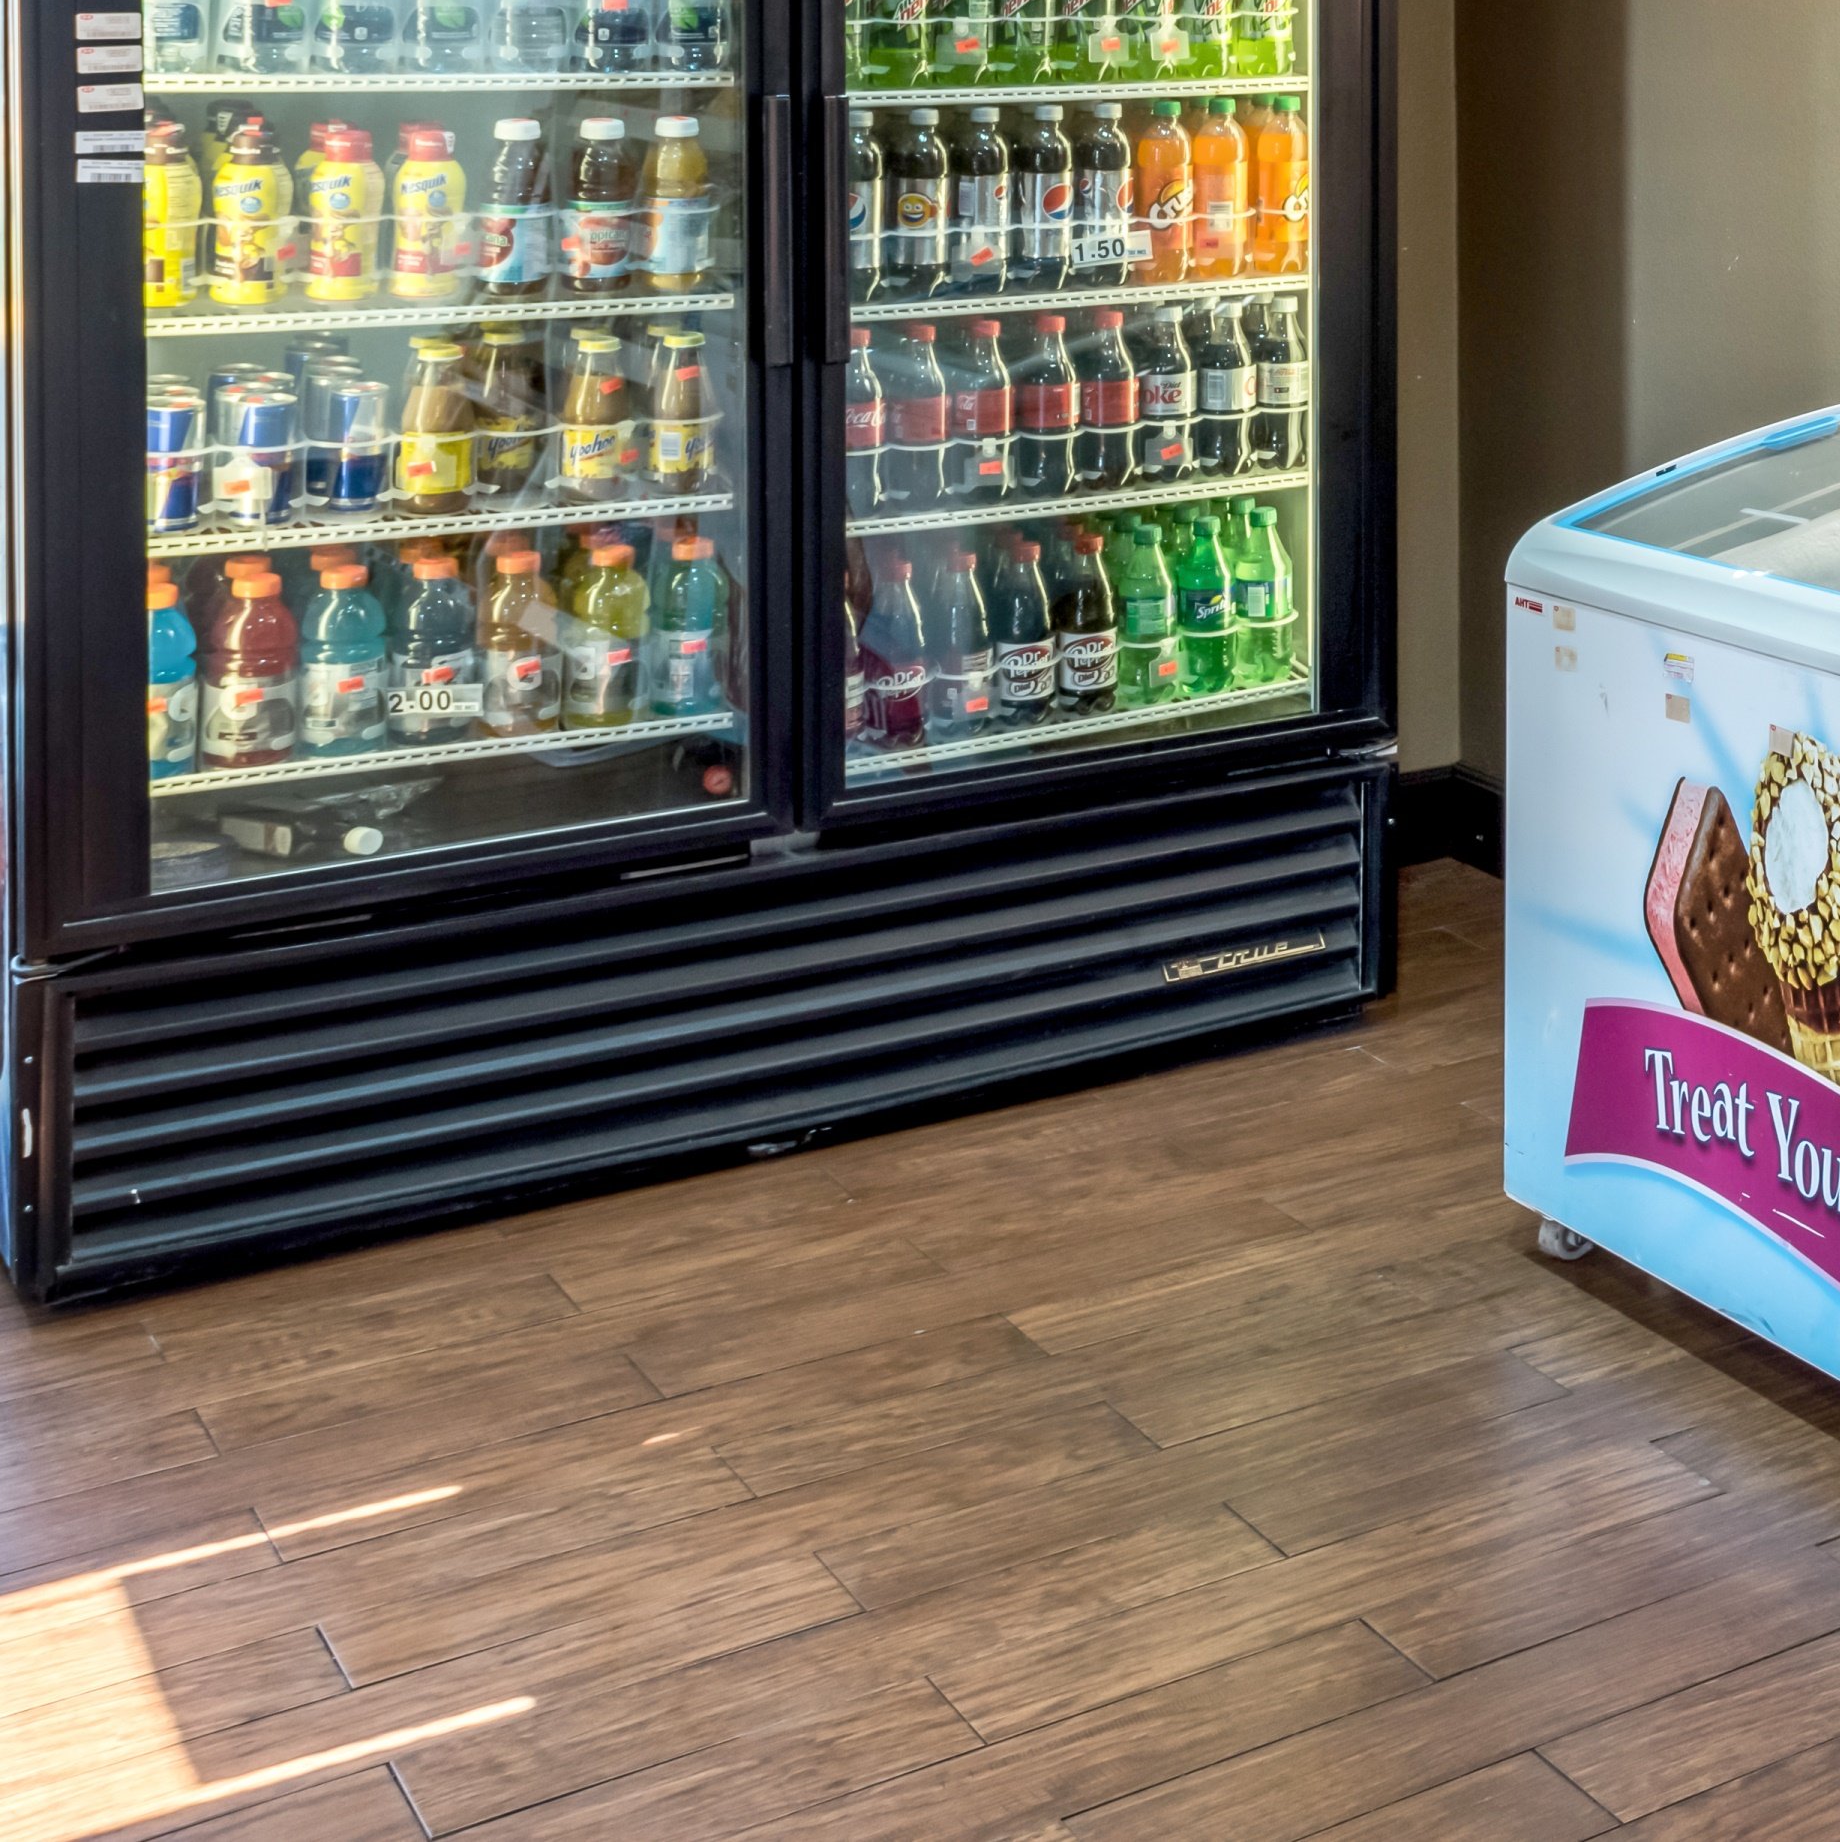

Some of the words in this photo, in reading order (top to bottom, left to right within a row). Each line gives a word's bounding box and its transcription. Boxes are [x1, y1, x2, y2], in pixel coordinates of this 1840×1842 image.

[1074, 238, 1125, 262] 1.50
[389, 689, 452, 714] 2.00
[1644, 1046, 1756, 1159] Treat
